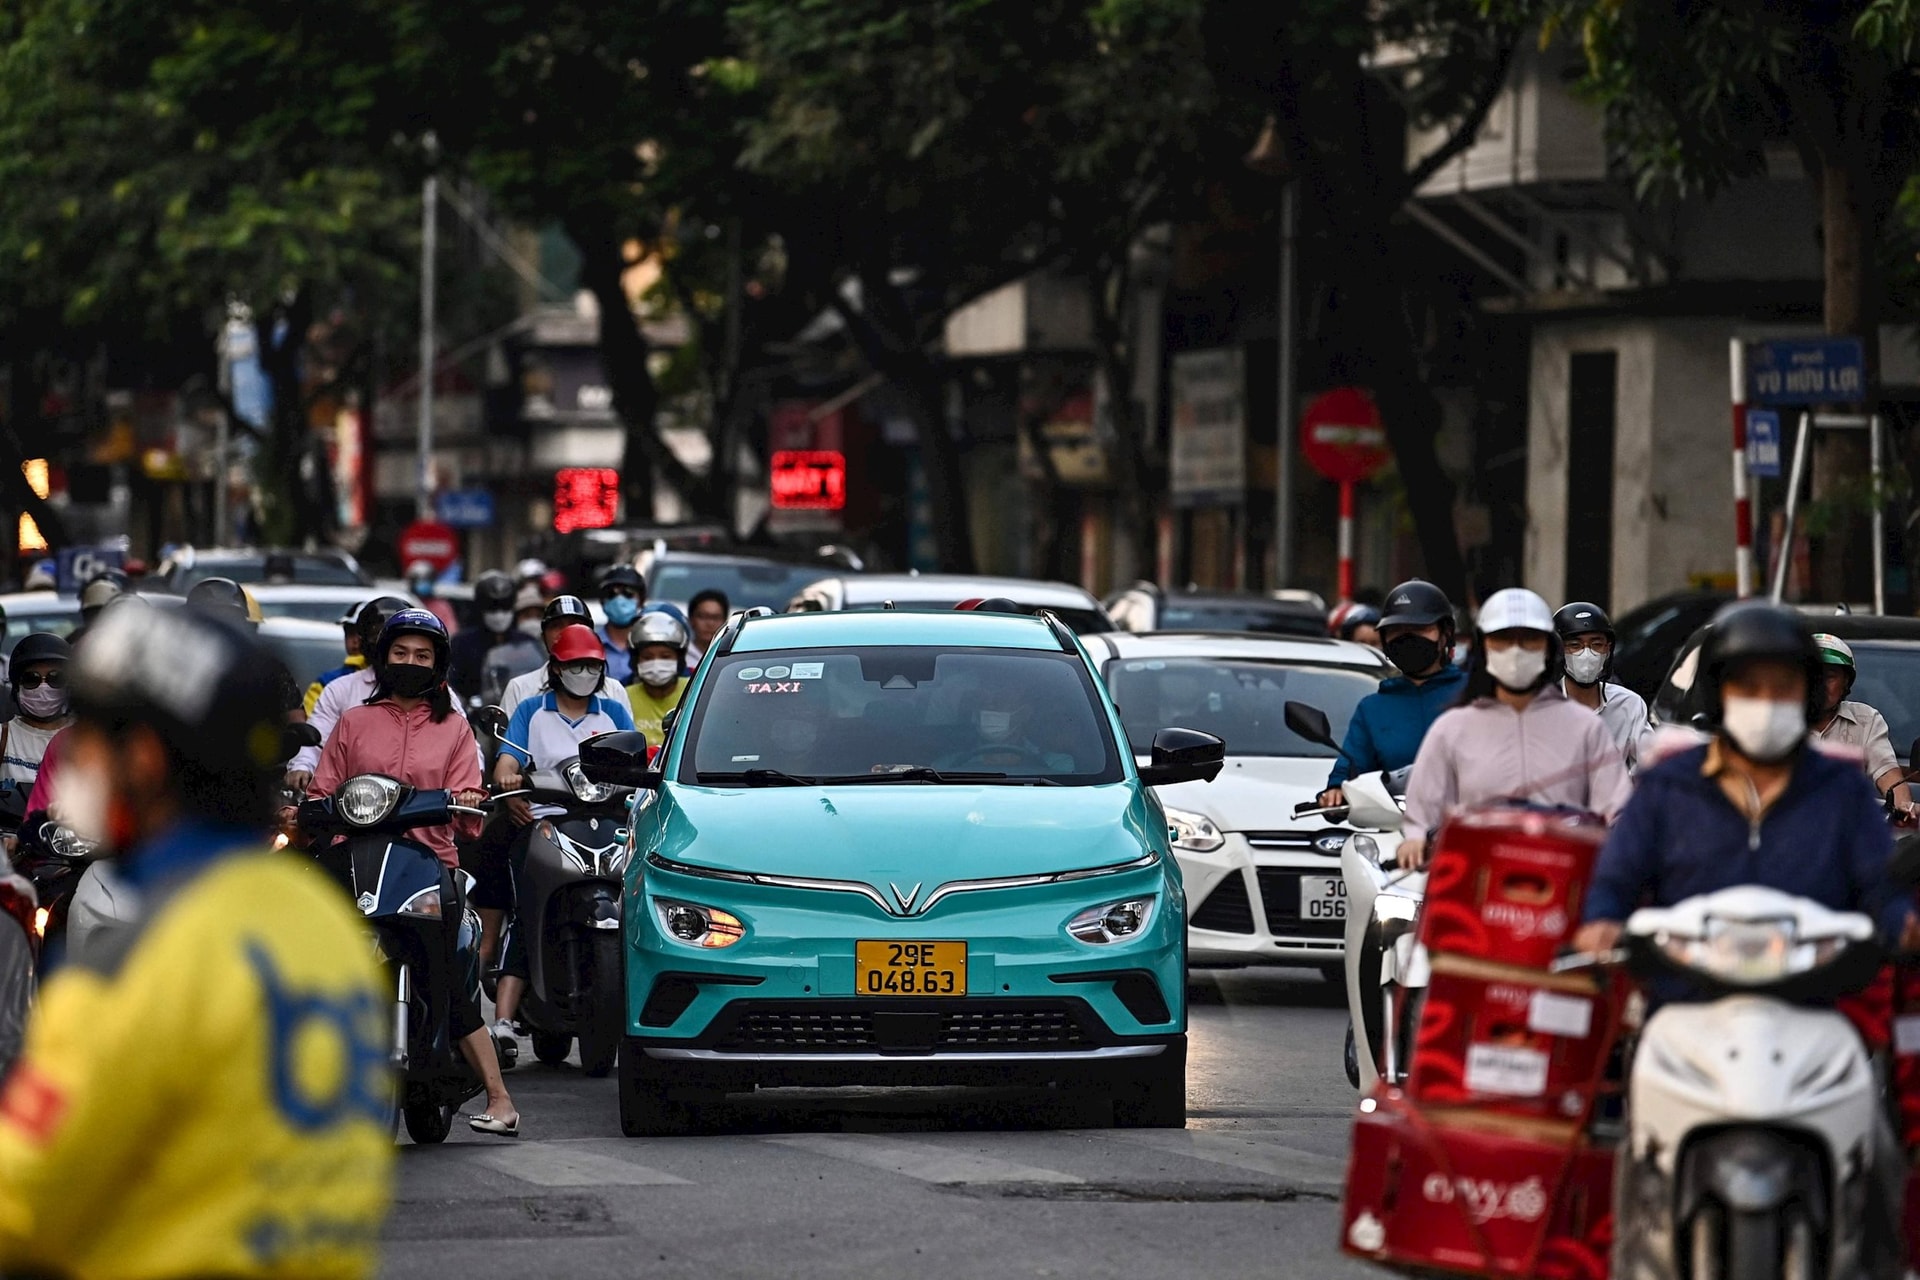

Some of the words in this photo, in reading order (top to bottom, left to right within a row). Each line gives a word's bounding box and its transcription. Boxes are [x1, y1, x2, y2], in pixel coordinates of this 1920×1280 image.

[748, 682, 801, 694] TAXI
[888, 944, 935, 967] 29E
[868, 970, 954, 993] 048.63
